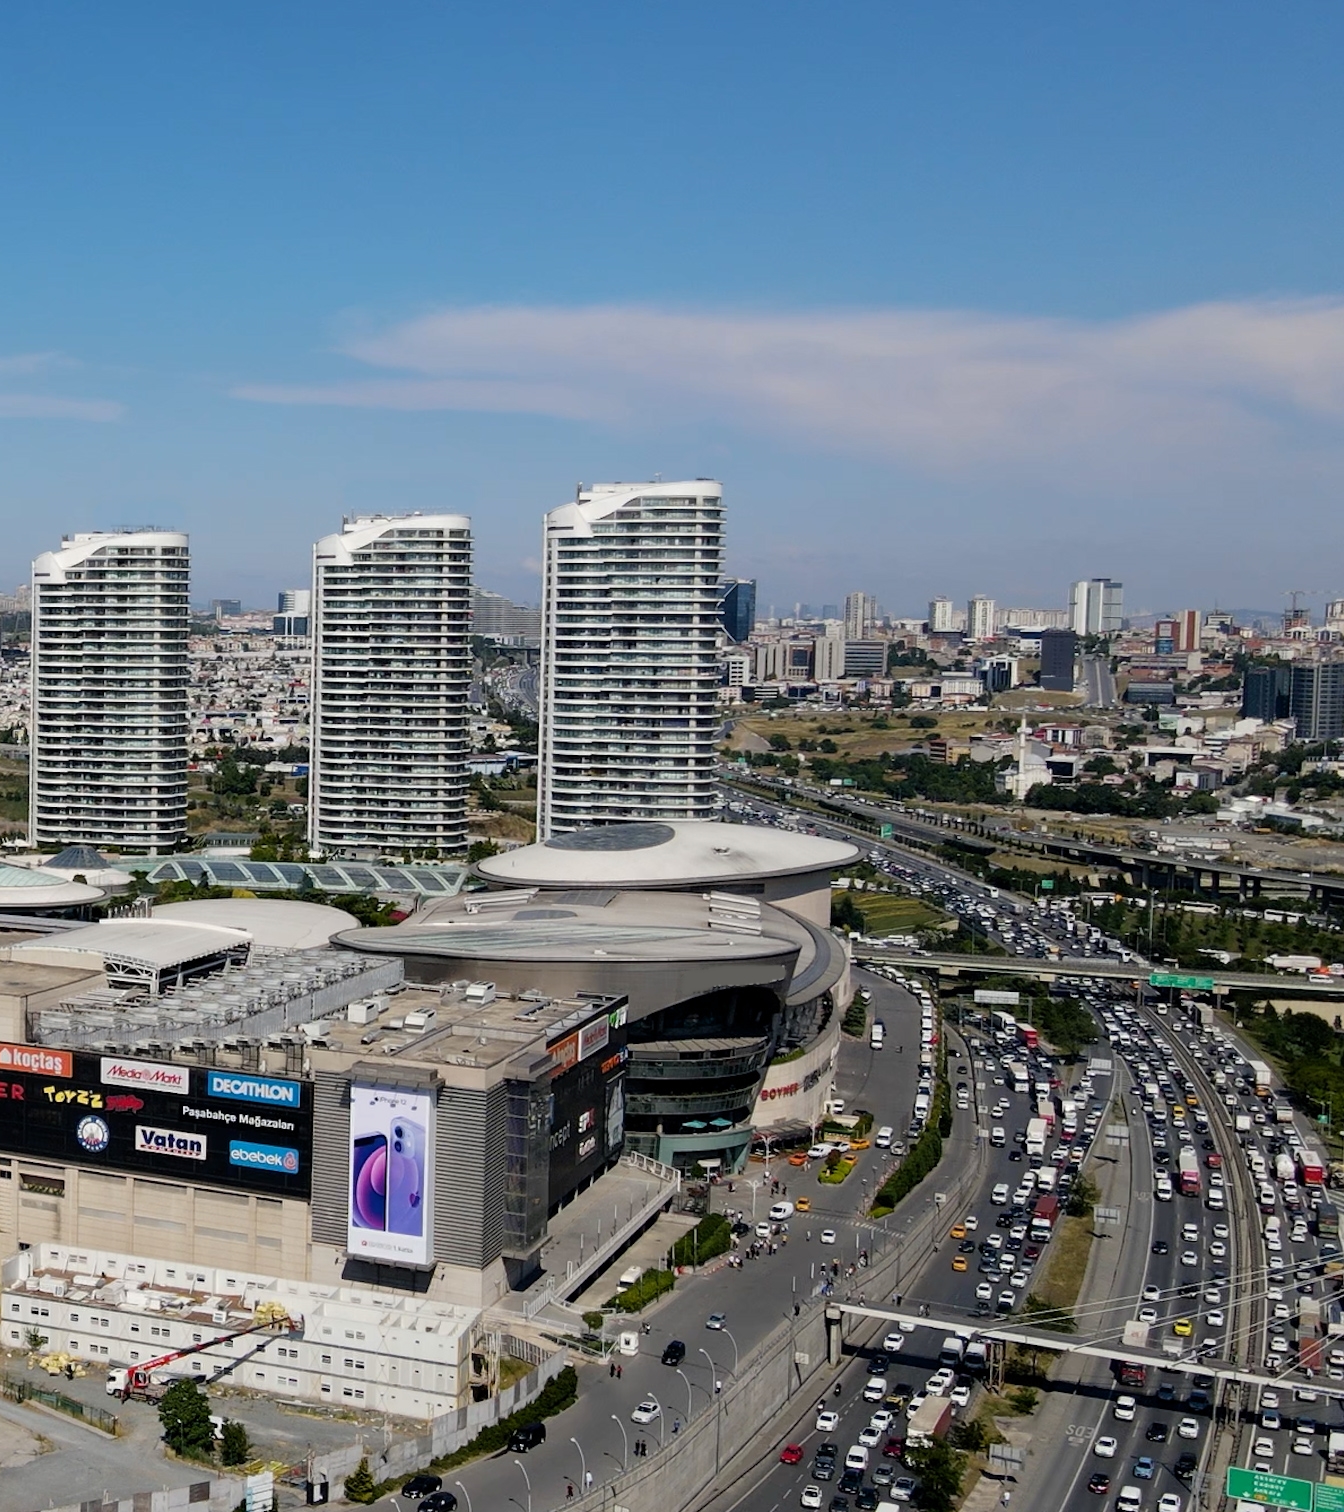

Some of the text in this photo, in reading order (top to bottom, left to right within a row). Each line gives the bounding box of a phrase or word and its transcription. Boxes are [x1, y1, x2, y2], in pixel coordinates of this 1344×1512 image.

[13, 1048, 63, 1074] koçtaş
[106, 1065, 142, 1079] Media
[149, 1070, 183, 1085] Markt
[212, 1077, 294, 1102] DECATHLON
[182, 1105, 295, 1131] Paşabahçe Mağazaları
[141, 1129, 202, 1152] Vatan
[230, 1149, 283, 1166] ebebek
